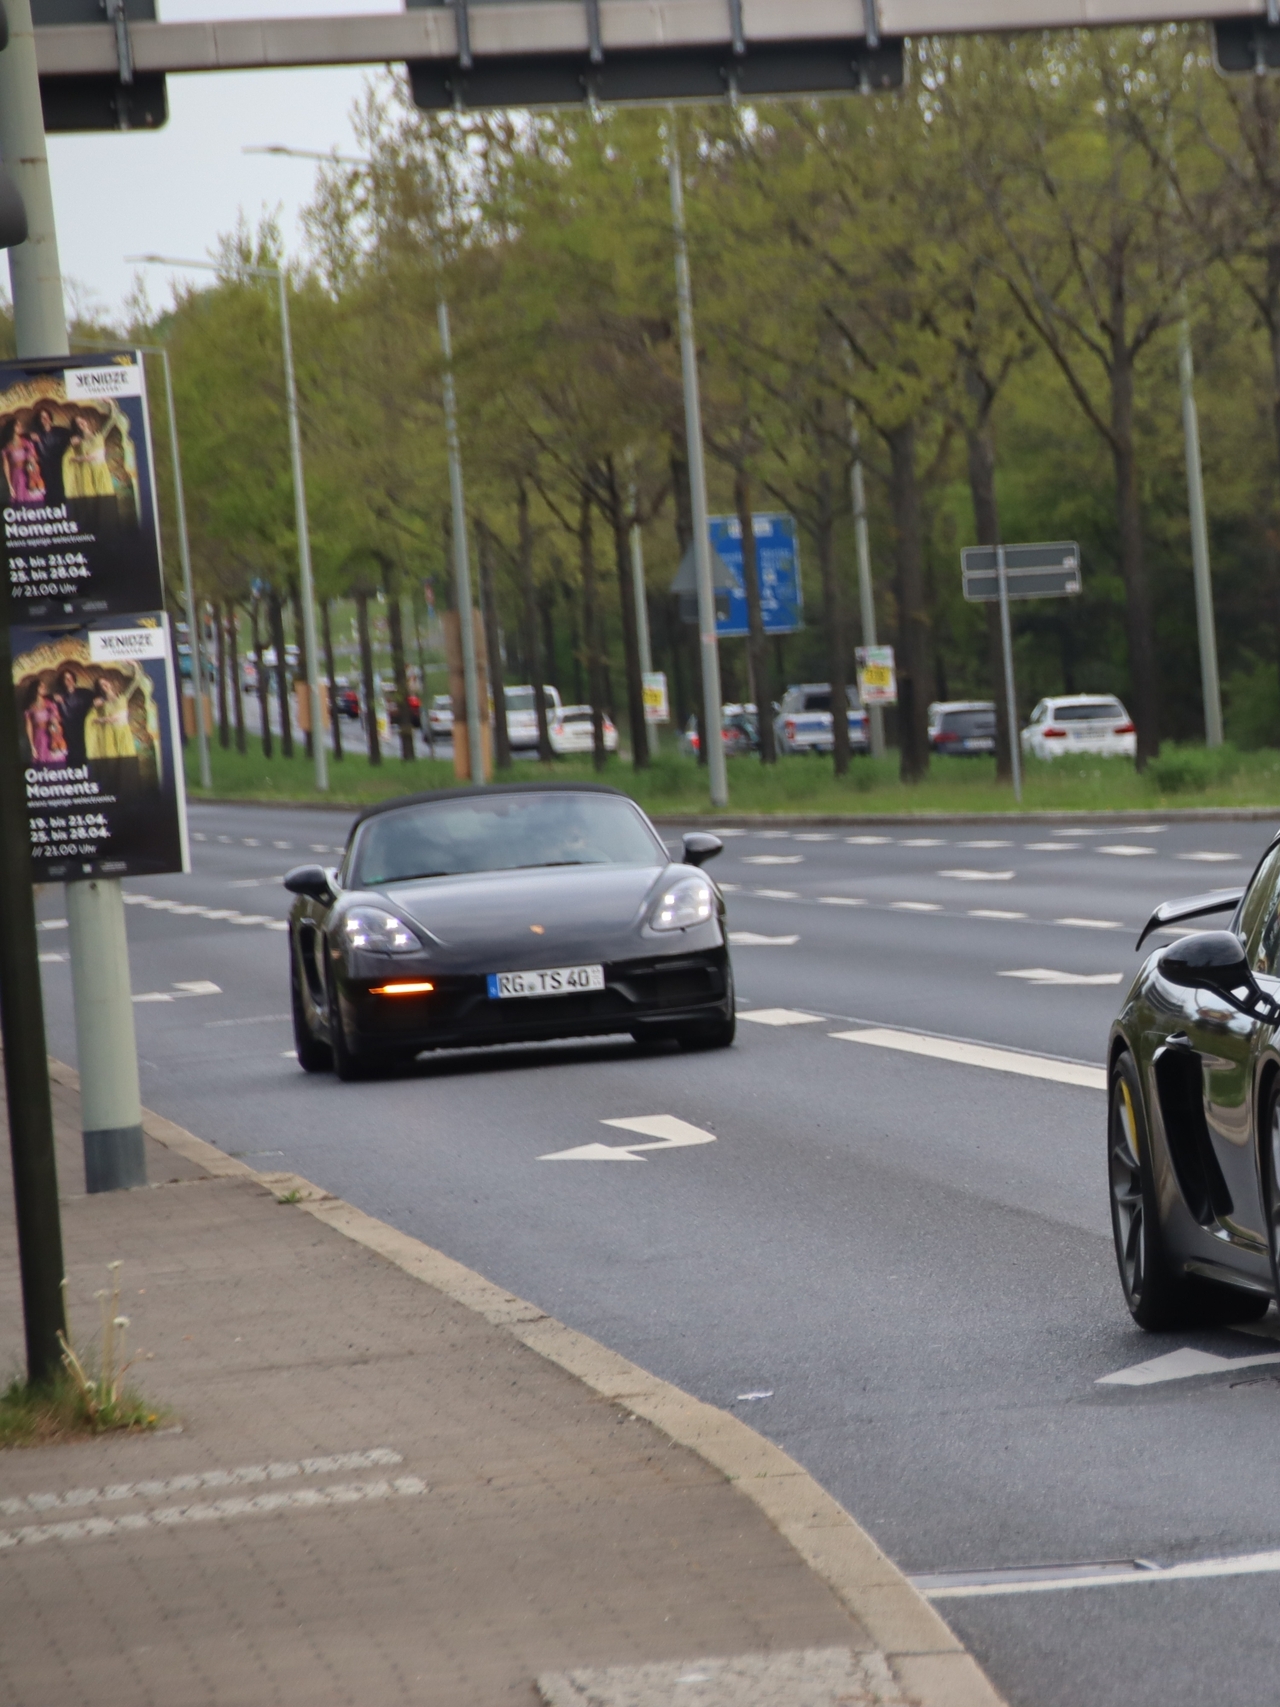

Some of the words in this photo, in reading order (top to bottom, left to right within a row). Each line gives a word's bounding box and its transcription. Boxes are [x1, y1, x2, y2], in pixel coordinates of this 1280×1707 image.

[3, 503, 67, 523] Oriental
[5, 520, 79, 539] Moments
[9, 557, 28, 569] 19.
[29, 555, 47, 568] bis
[48, 552, 88, 567] 21.04.
[30, 568, 48, 581] bis
[49, 565, 92, 580] 28.04.
[59, 582, 78, 595] Uhr
[24, 764, 89, 783] Oriental
[25, 781, 100, 799] Moments
[29, 817, 49, 830] 19.
[49, 816, 67, 829] bis
[68, 812, 109, 827] 21.04.
[50, 829, 68, 841] bis
[69, 826, 112, 840] 28.04.
[78, 844, 97, 855] Uhr
[500, 973, 525, 994] RG
